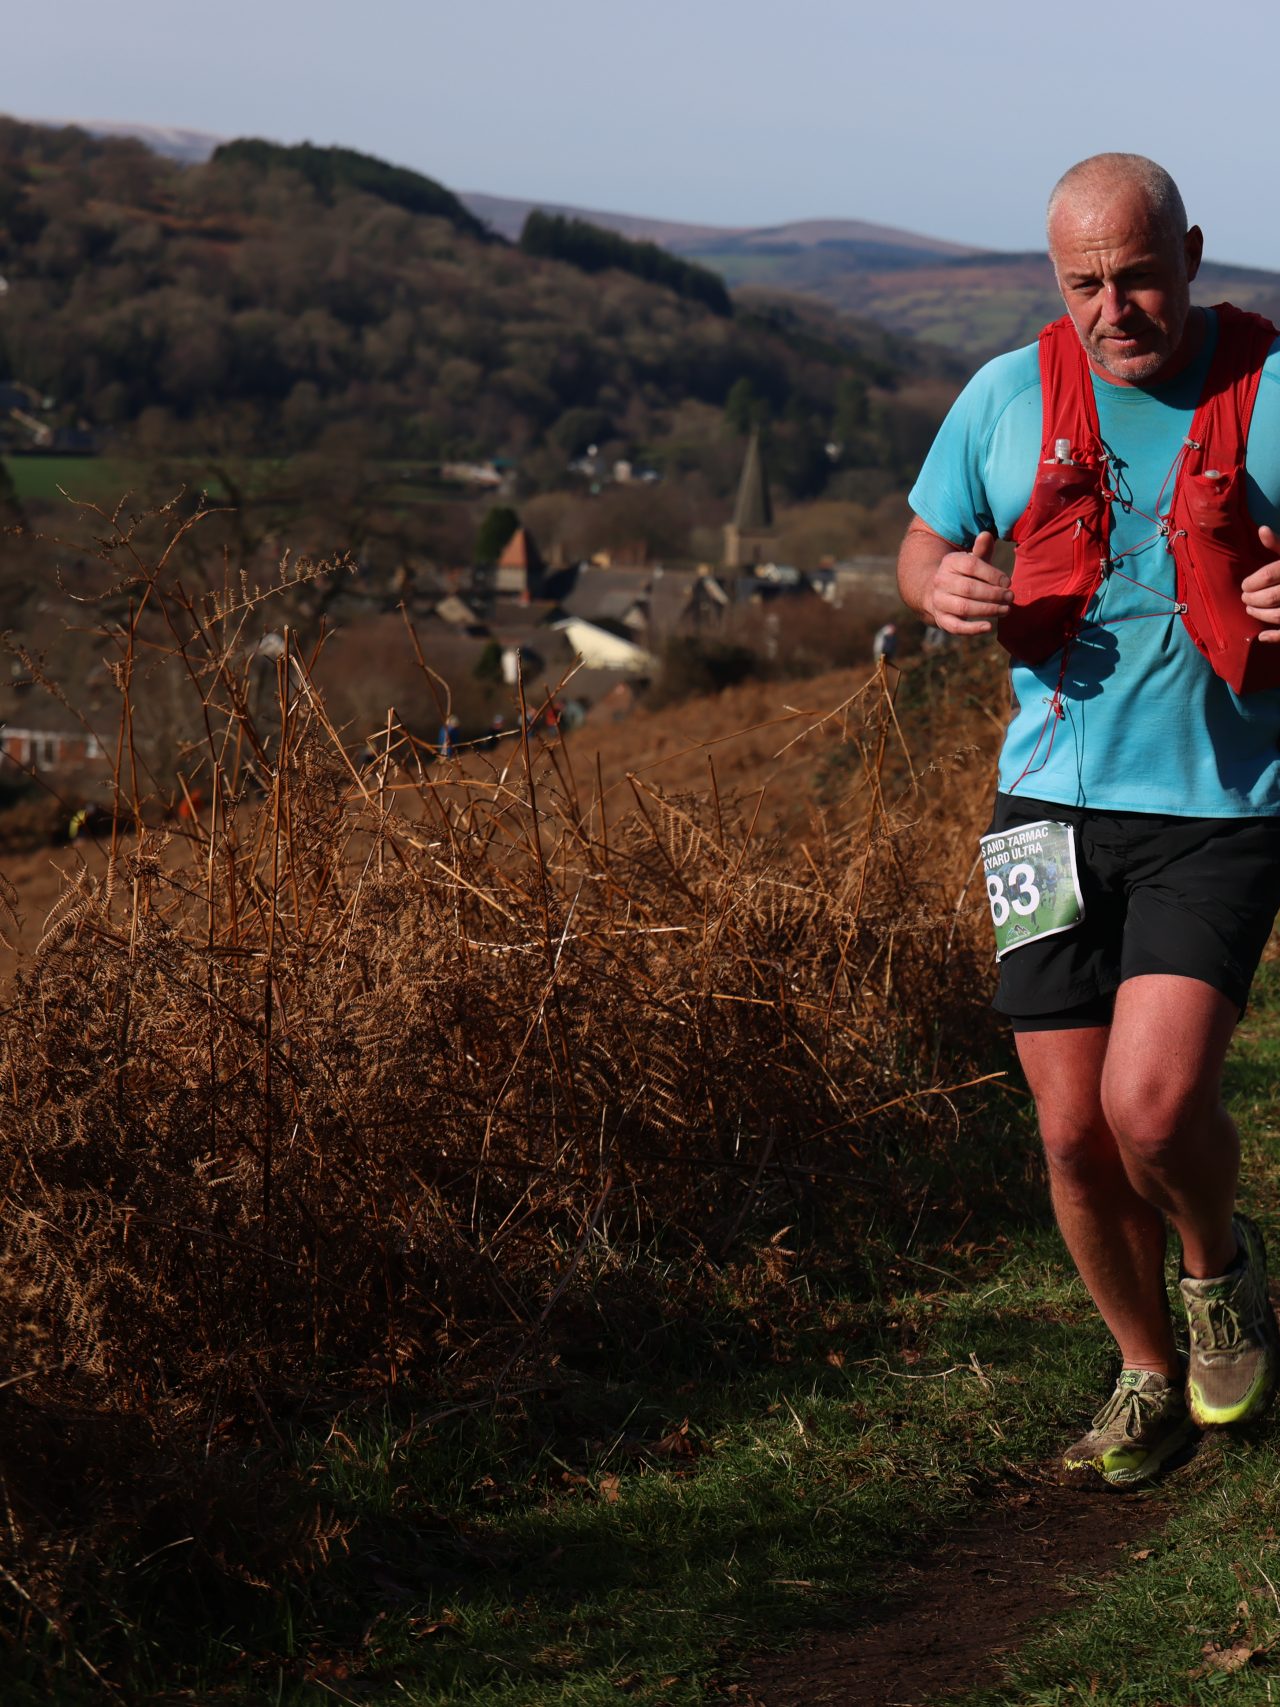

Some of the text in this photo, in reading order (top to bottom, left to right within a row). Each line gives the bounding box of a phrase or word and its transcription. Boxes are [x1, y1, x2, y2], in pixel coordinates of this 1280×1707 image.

[987, 839, 1005, 855] AND
[1007, 826, 1049, 847] TARMAC
[1011, 842, 1043, 860] ULTRA
[986, 863, 1040, 927] 83
